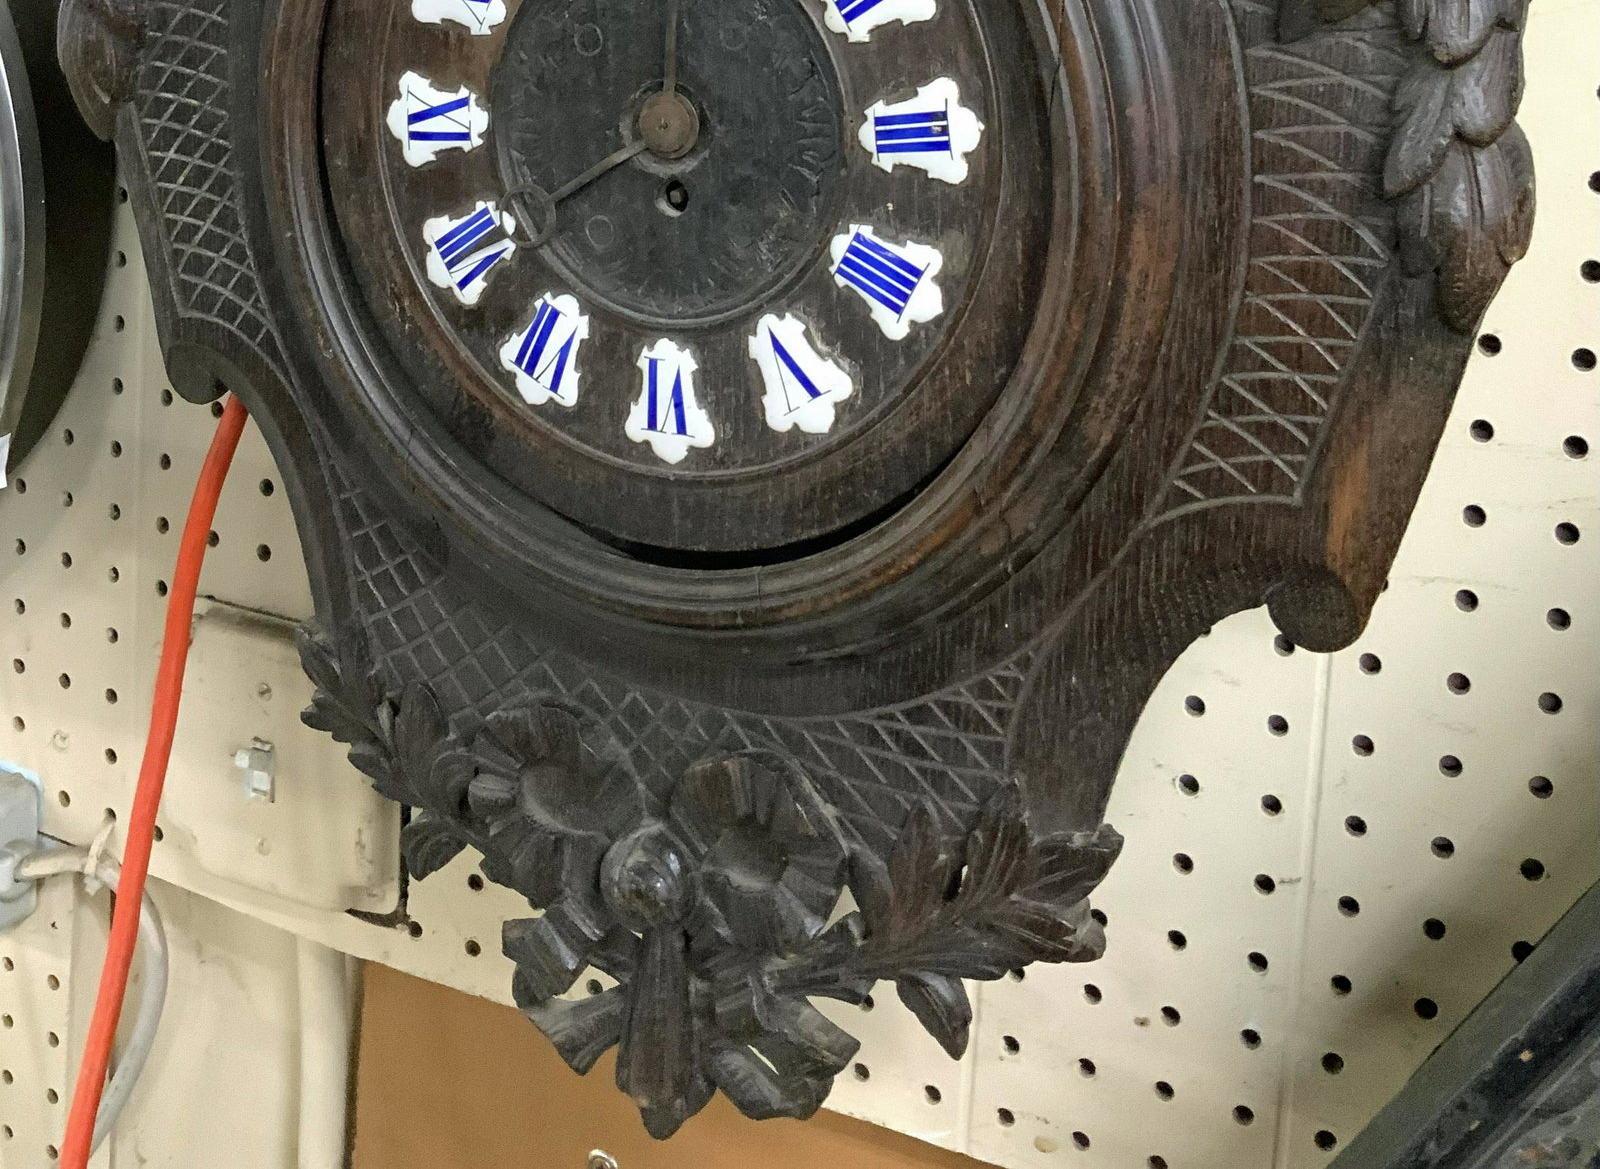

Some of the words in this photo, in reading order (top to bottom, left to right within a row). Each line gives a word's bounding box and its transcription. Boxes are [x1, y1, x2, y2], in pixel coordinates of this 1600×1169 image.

[406, 86, 473, 151] IX
[872, 98, 953, 162] III
[834, 225, 930, 323] IIII
[507, 298, 581, 401] VII
[767, 326, 831, 417] V
[640, 356, 696, 439] VI
